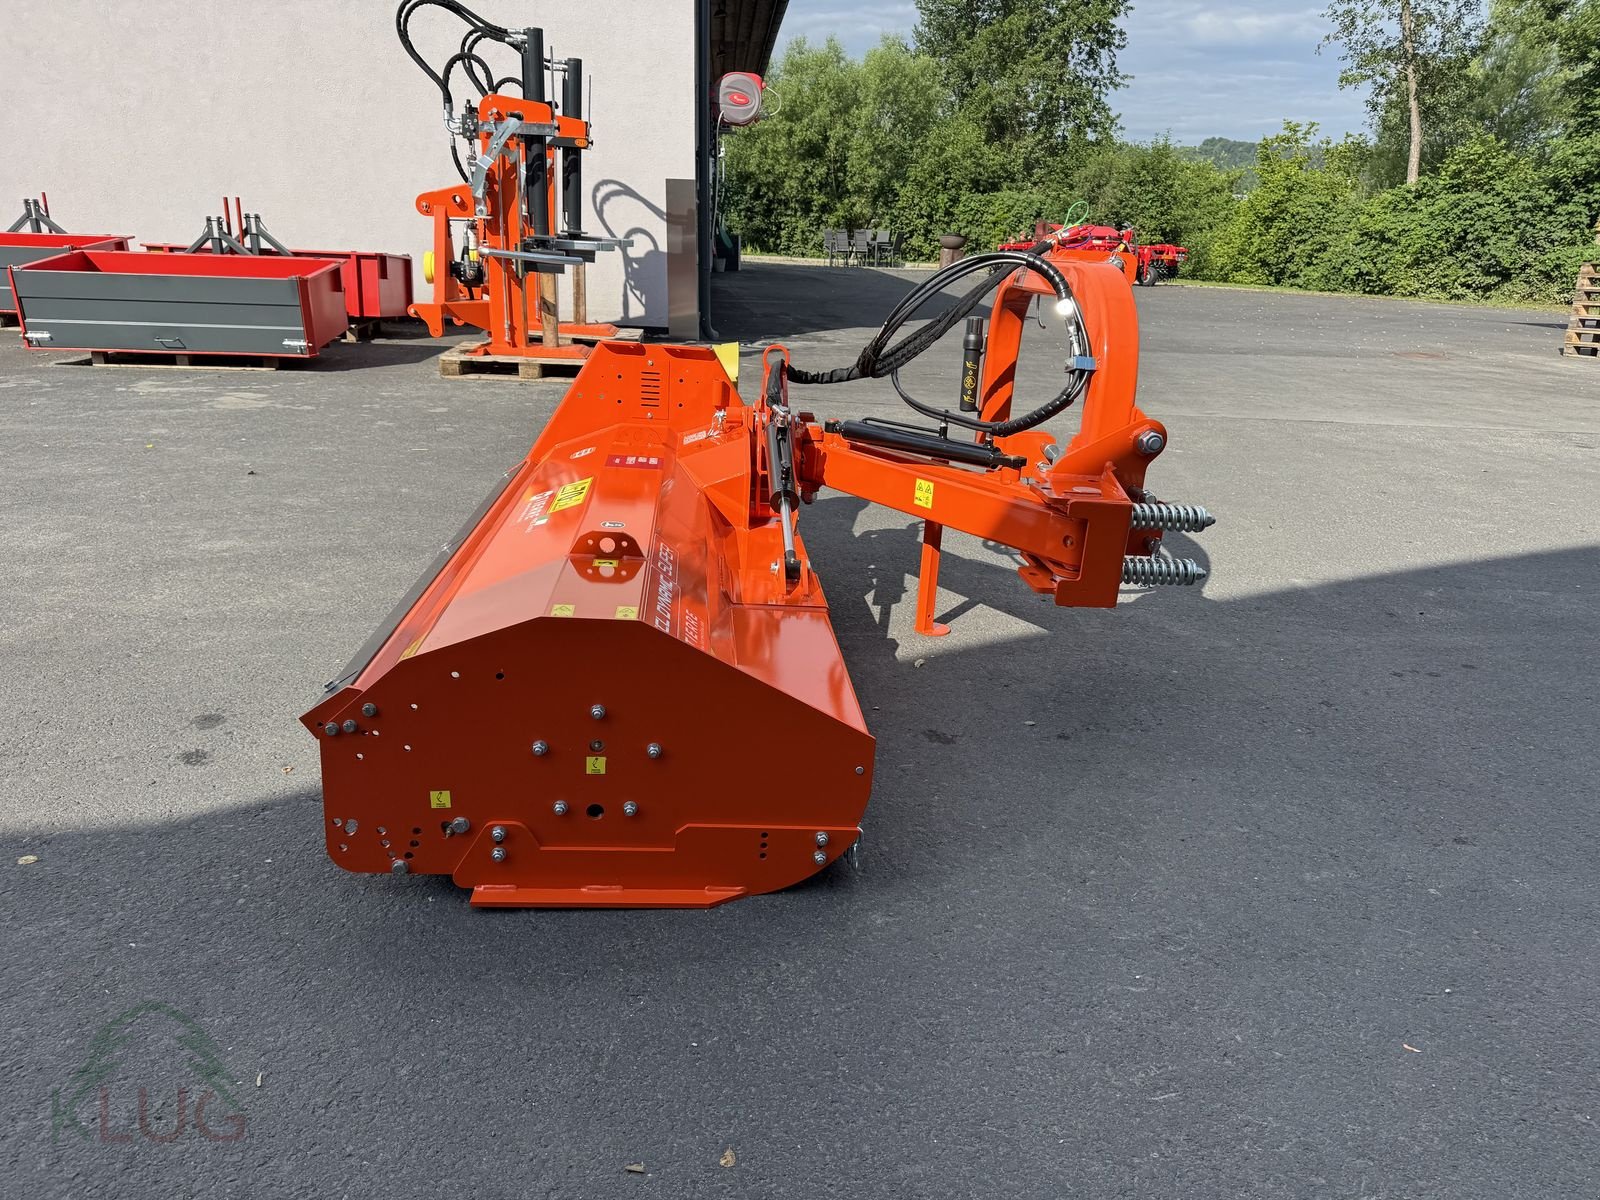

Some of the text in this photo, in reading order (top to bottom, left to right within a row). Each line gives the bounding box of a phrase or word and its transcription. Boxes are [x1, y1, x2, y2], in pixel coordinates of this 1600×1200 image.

[658, 542, 674, 576] SUPER
[655, 616, 671, 633] CL
[684, 609, 699, 645] TIERRE
